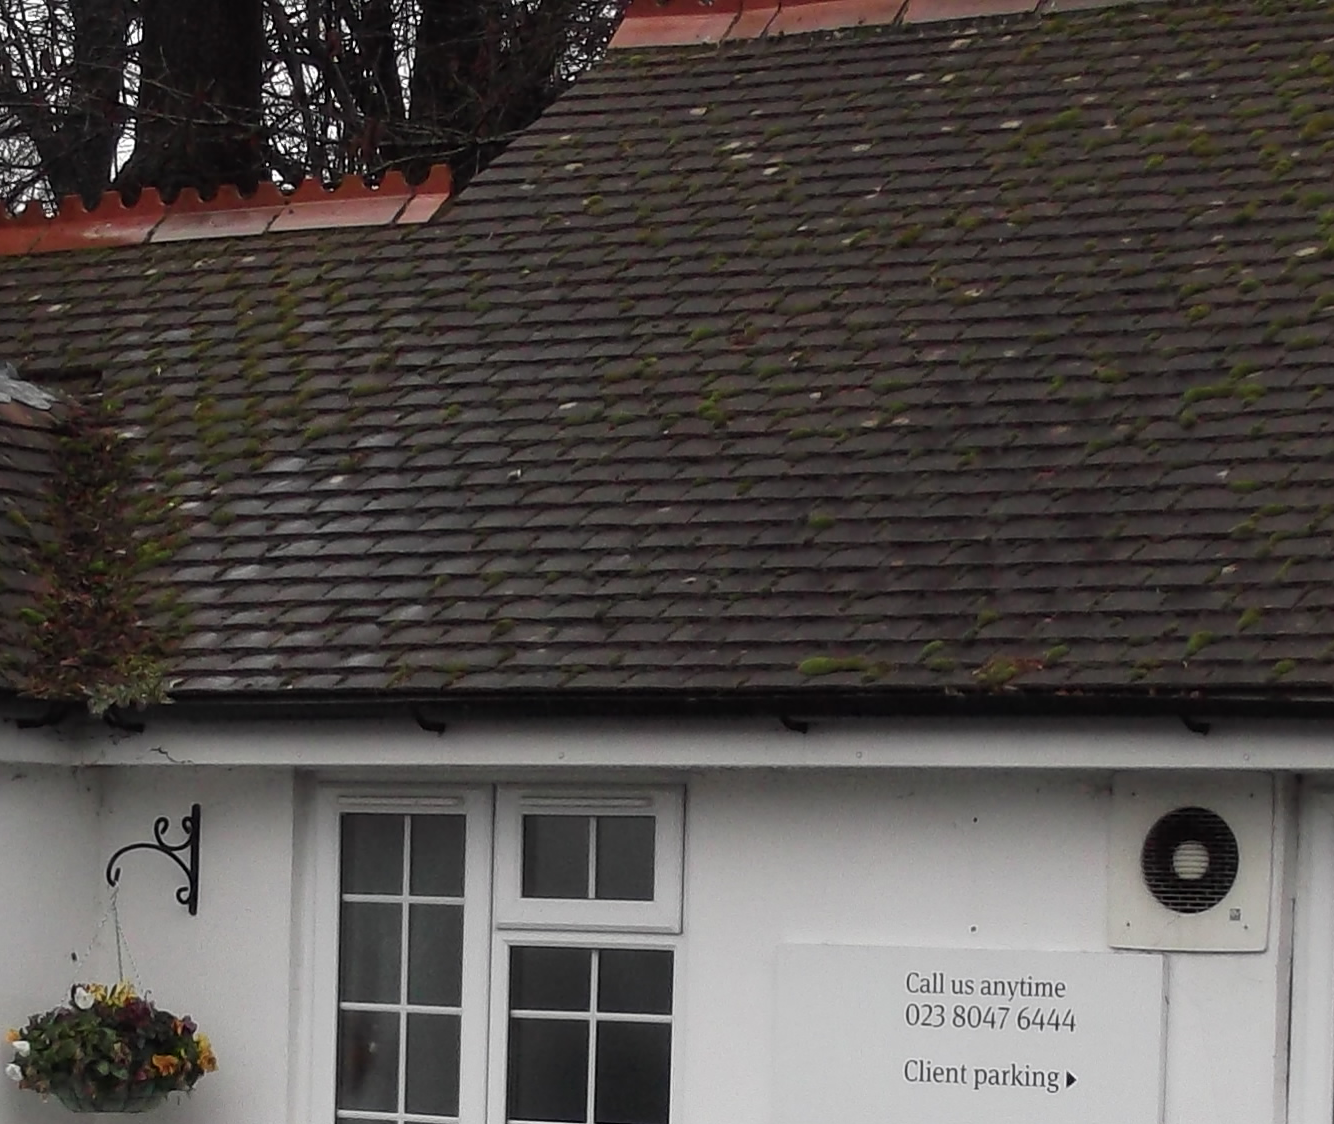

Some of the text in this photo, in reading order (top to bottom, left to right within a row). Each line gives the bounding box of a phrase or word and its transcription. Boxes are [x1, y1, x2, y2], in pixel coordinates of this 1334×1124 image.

[906, 971, 1066, 1002] Call us anytime
[905, 1003, 1077, 1032] 023 8047 6444
[904, 1059, 1060, 1093] Client parking
